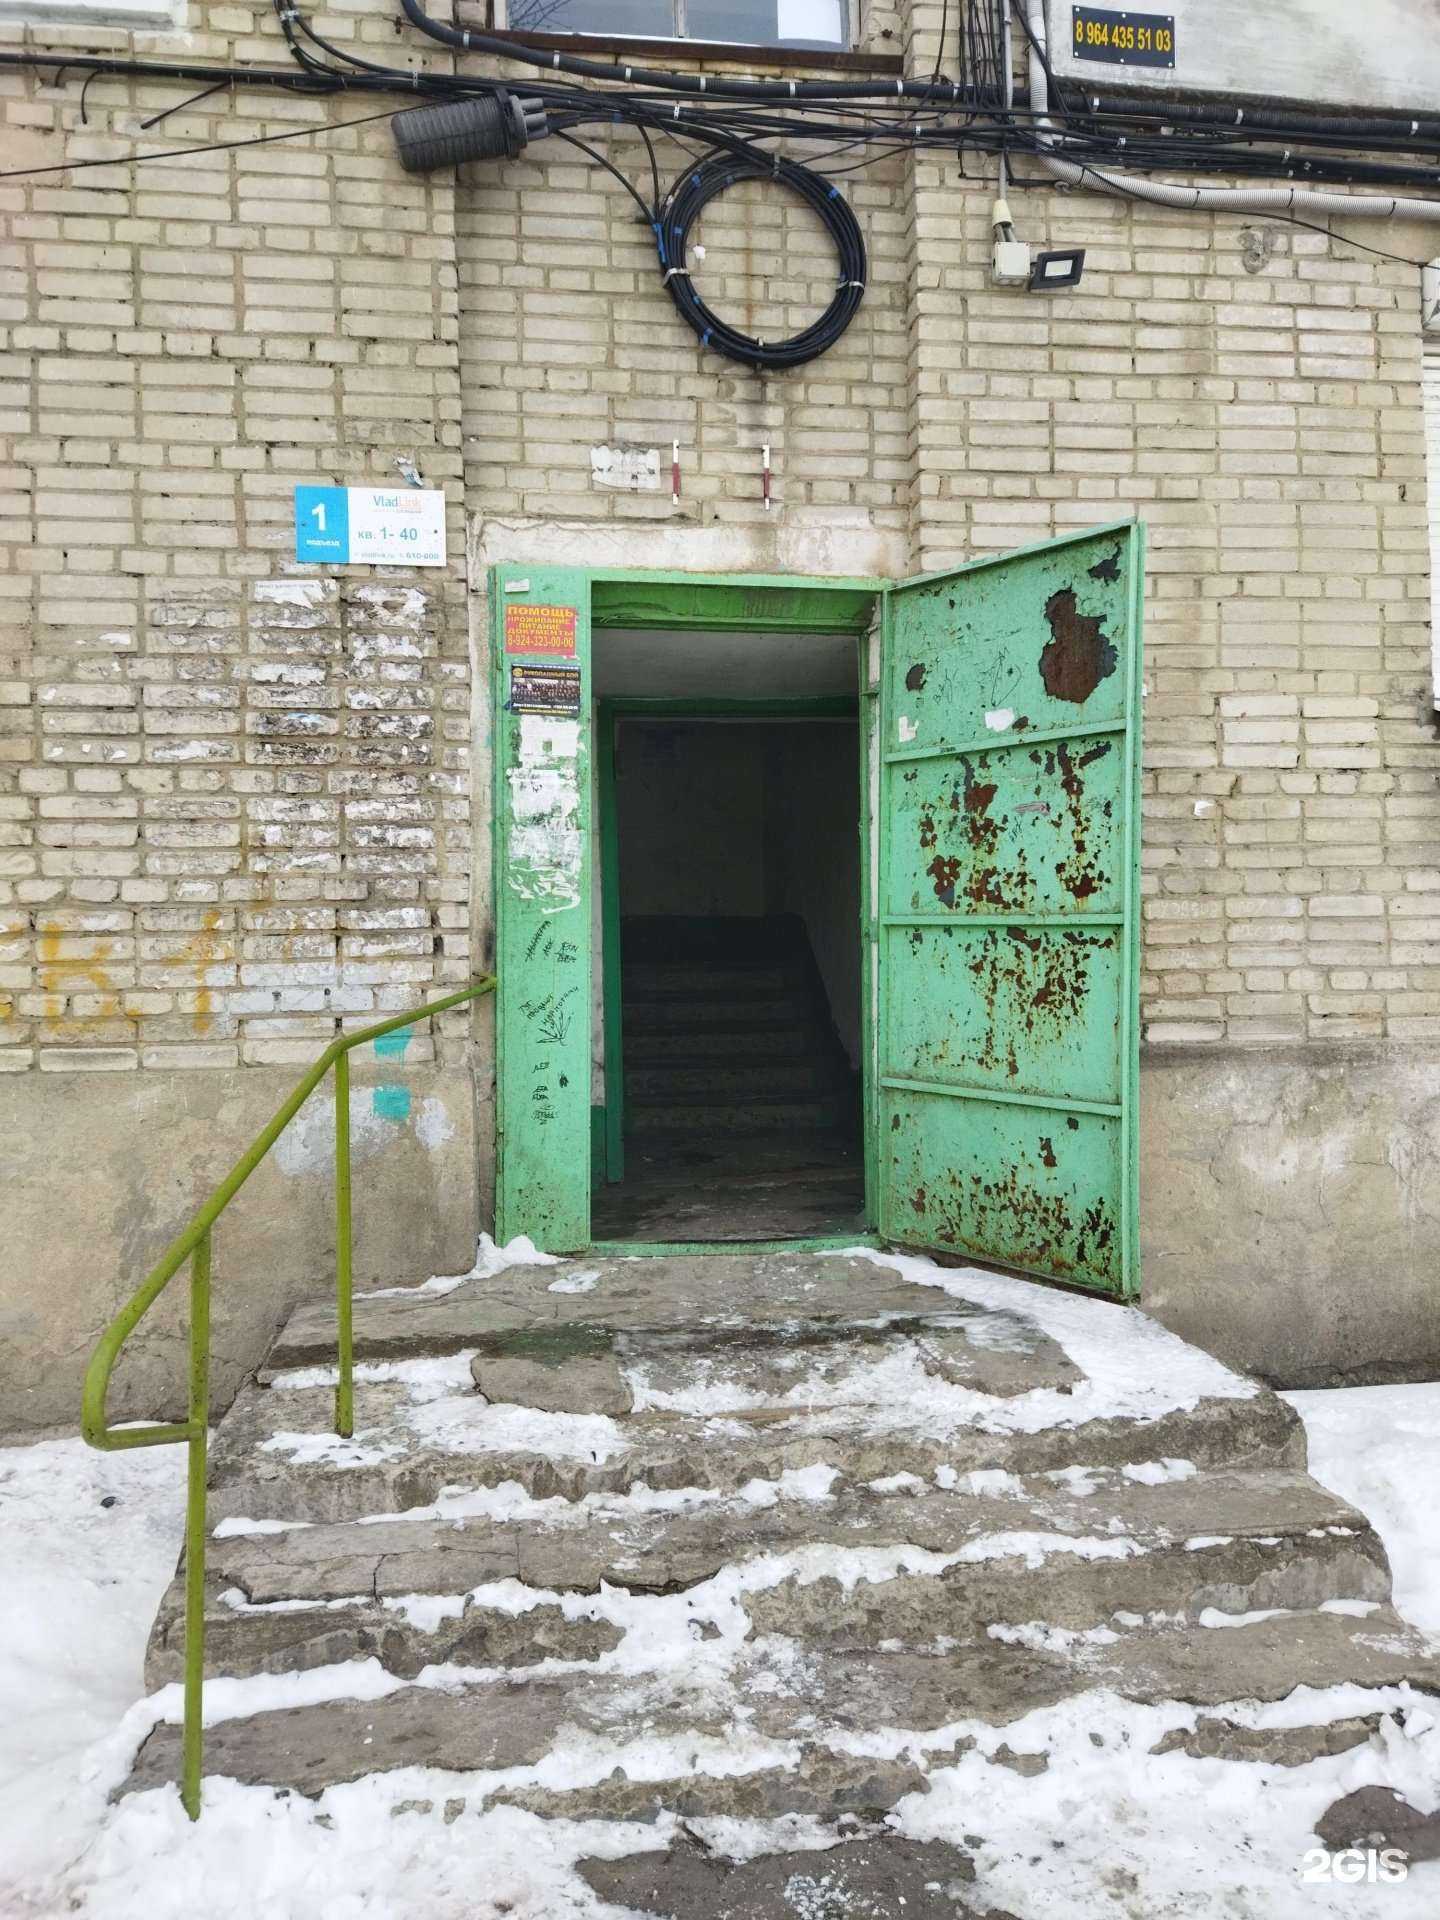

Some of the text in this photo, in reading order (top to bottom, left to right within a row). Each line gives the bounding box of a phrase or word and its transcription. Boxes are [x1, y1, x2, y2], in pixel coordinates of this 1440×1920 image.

[1076, 20, 1171, 51] 8 964 435 51 03
[311, 502, 327, 531] 1
[399, 528, 418, 541] 40
[508, 606, 574, 617] ПОМОЩЬ
